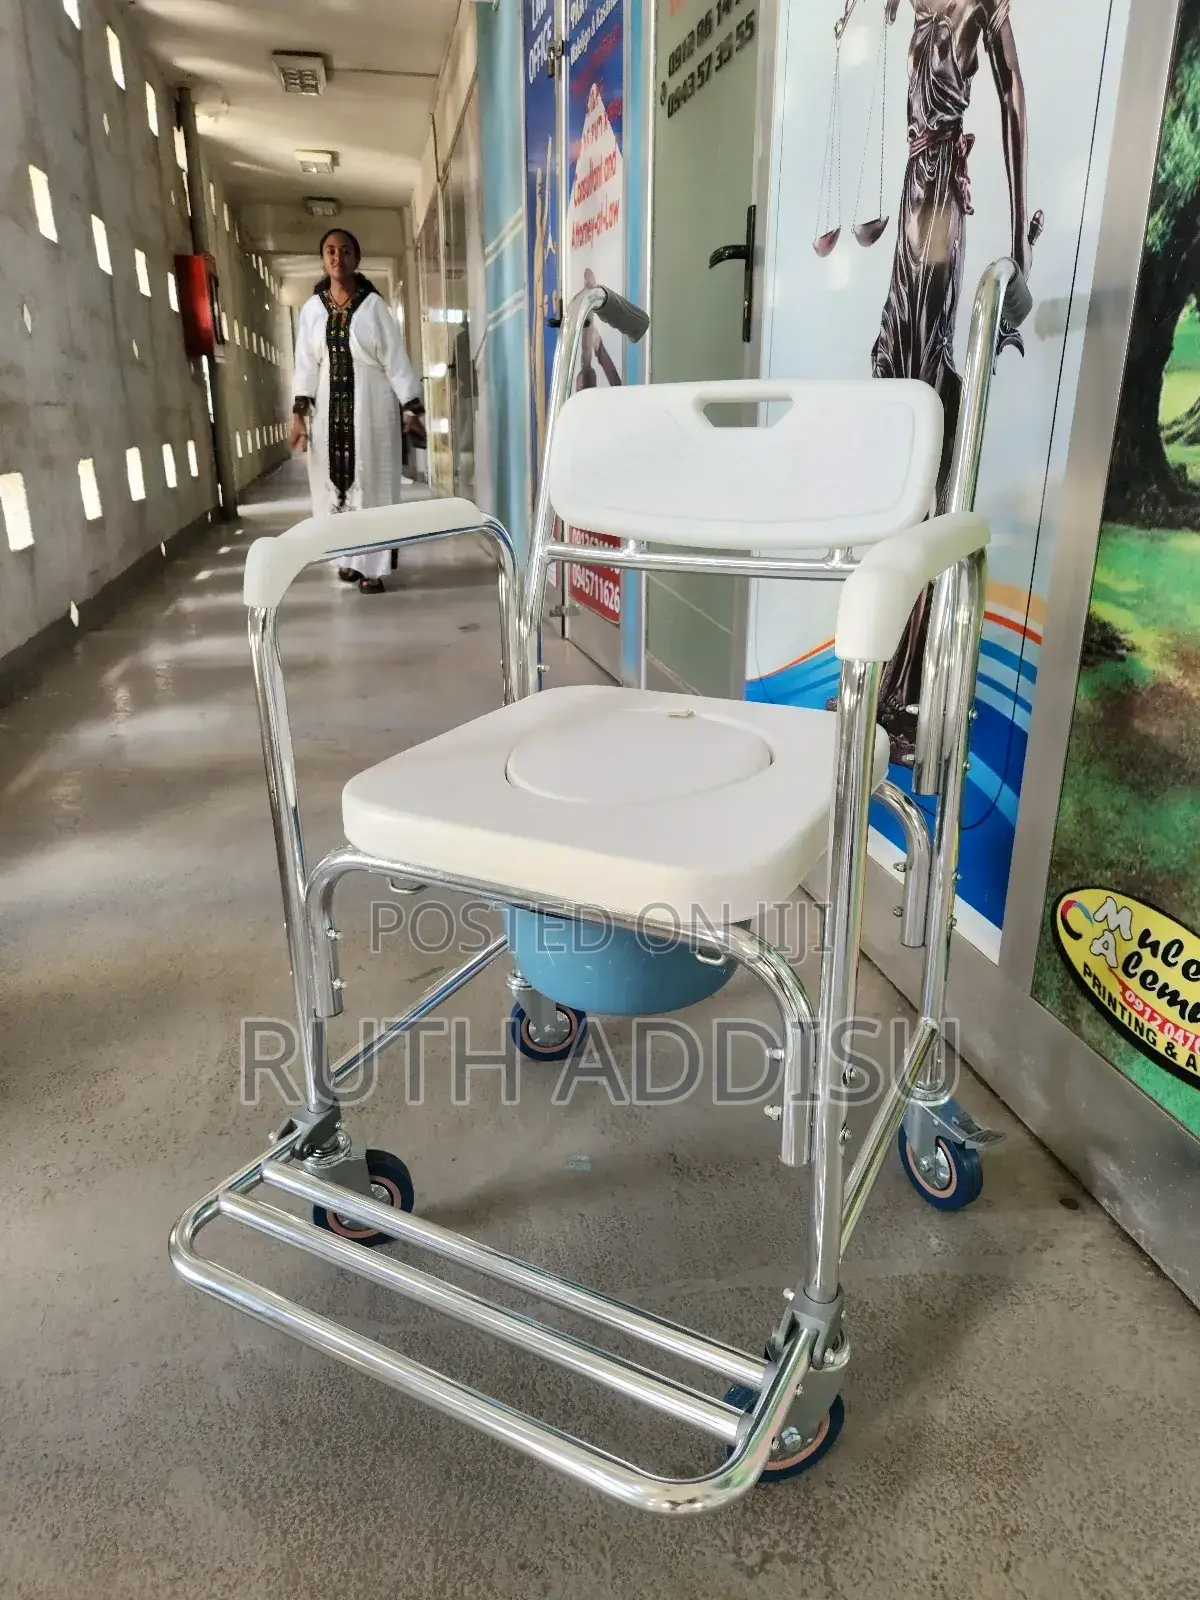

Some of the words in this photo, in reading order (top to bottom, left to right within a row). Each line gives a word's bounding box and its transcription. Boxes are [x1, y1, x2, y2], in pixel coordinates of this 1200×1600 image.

[697, 52, 713, 90] 57
[736, 9, 755, 52] 55
[572, 563, 620, 614] 0945711626
[1083, 961, 1158, 1047] PRINTING
[1164, 1041, 1178, 1061] &
[1125, 990, 1163, 1033] 0912
